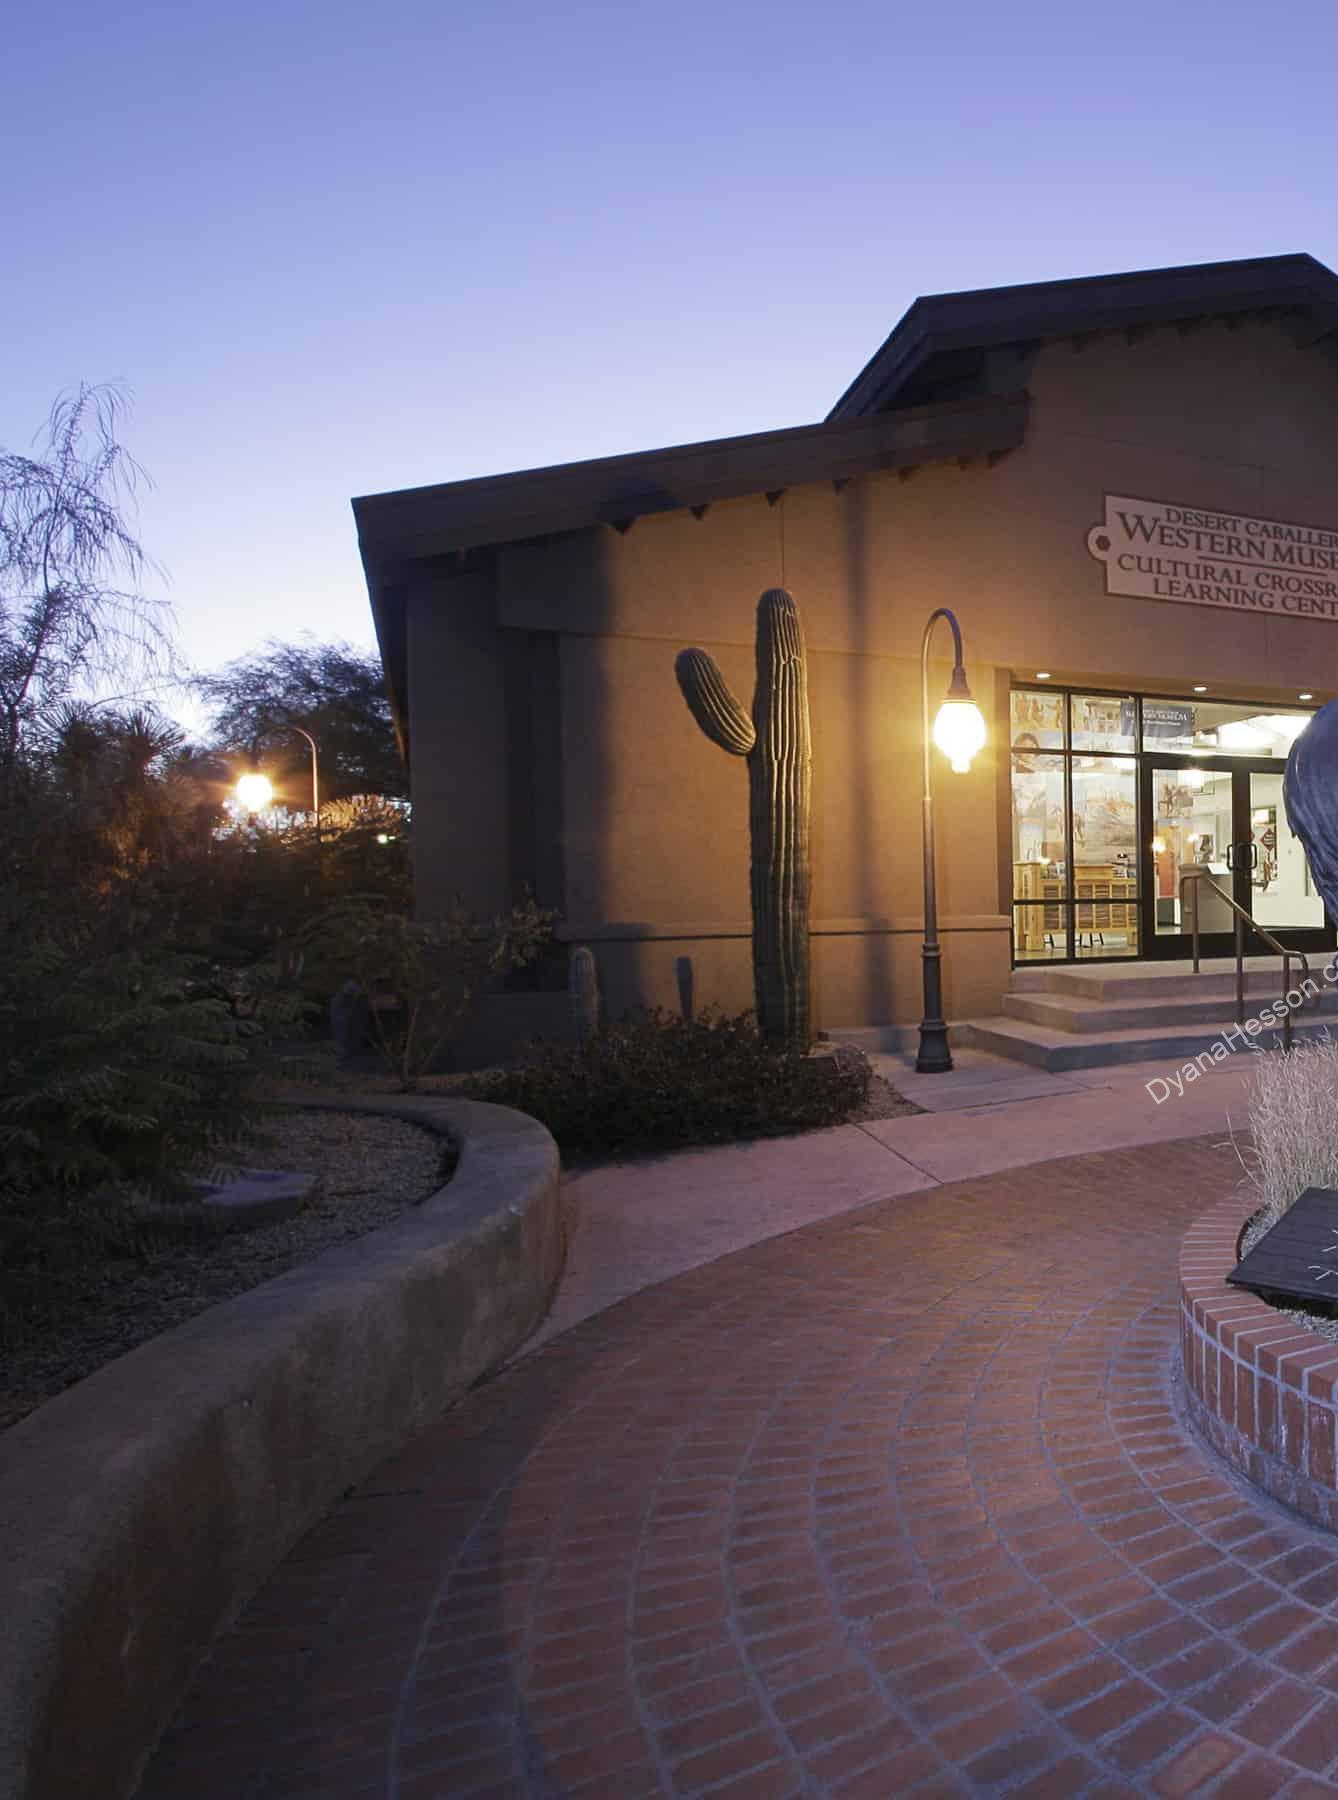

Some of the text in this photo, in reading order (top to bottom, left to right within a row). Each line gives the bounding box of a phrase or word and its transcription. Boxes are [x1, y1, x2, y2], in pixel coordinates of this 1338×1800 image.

[1115, 511, 1267, 561] WESTERN
[1165, 508, 1241, 533] DESERT
[1117, 553, 1249, 586] CULTURAL
[1153, 578, 1274, 609] LEARNING
